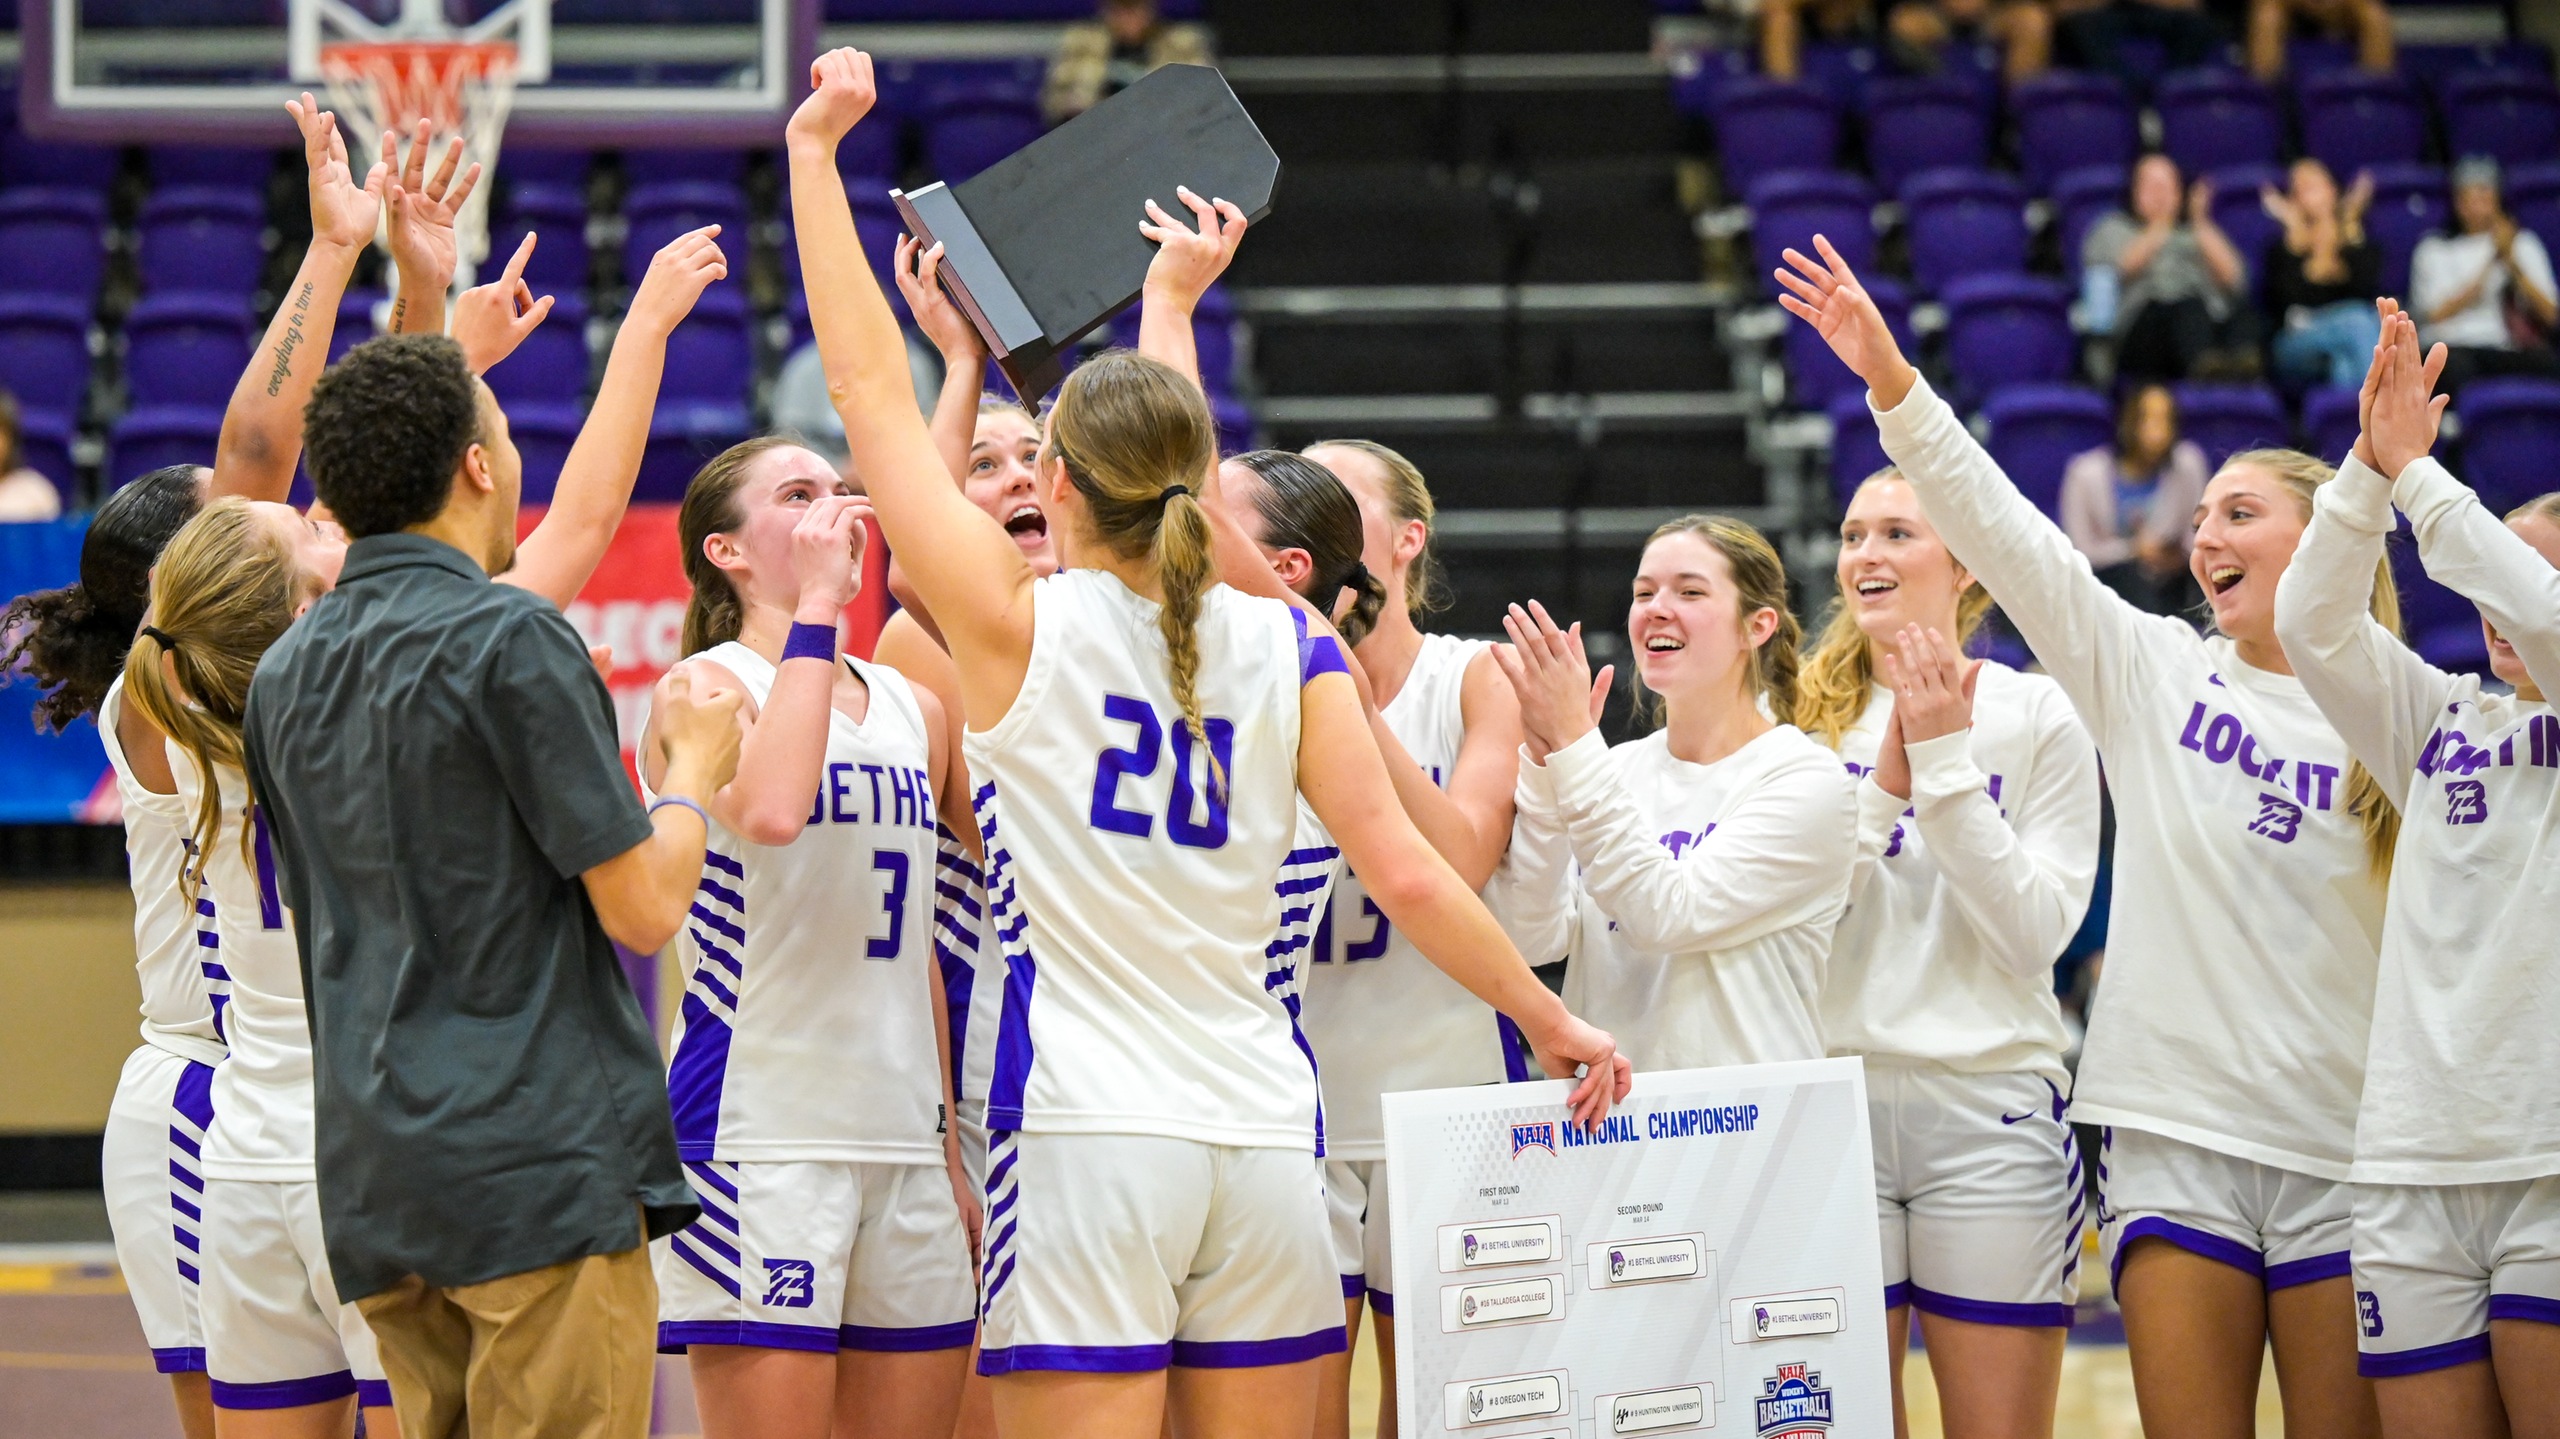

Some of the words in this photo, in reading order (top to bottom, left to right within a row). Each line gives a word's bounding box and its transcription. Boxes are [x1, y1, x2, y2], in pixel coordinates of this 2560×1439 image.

[294, 281, 314, 311] time
[289, 313, 305, 327] in
[267, 327, 304, 397] everything
[1087, 690, 1237, 850] 20
[2296, 760, 2340, 812] IT
[864, 847, 910, 961] 3
[1512, 1124, 1554, 1153] NAIA
[1648, 1104, 1759, 1139] CHAMPIONSHIP
[1479, 1187, 1497, 1198] FIRST
[1498, 1185, 1520, 1196] ROUND
[1491, 1198, 1502, 1206] MAR
[1617, 1204, 1642, 1216] SECOND
[1642, 1202, 1664, 1213] ROUND
[1632, 1216, 1643, 1224] MAR
[1481, 1242, 1488, 1250] #1
[1489, 1240, 1510, 1250] BETHEL
[1511, 1238, 1545, 1248] UNIVERSITY
[1628, 1259, 1635, 1267] #1
[1635, 1256, 1656, 1266] BETHEL
[1656, 1253, 1690, 1264] UNIVERSITY
[1480, 1299, 1490, 1307] #16
[1490, 1295, 1521, 1306] TALLADEGA
[1520, 1292, 1546, 1303] COLLEGE
[1778, 1314, 1798, 1323] BETHEL
[1799, 1311, 1832, 1322] UNIVERSITY
[1778, 1364, 1807, 1385] NAIA
[1499, 1394, 1526, 1405] OREGON
[1527, 1391, 1545, 1402] TECH
[1638, 1405, 1671, 1416] HUNTINGTON
[1671, 1401, 1700, 1412] UNIVERSITY
[1758, 1394, 1830, 1428] BASKETBALL
